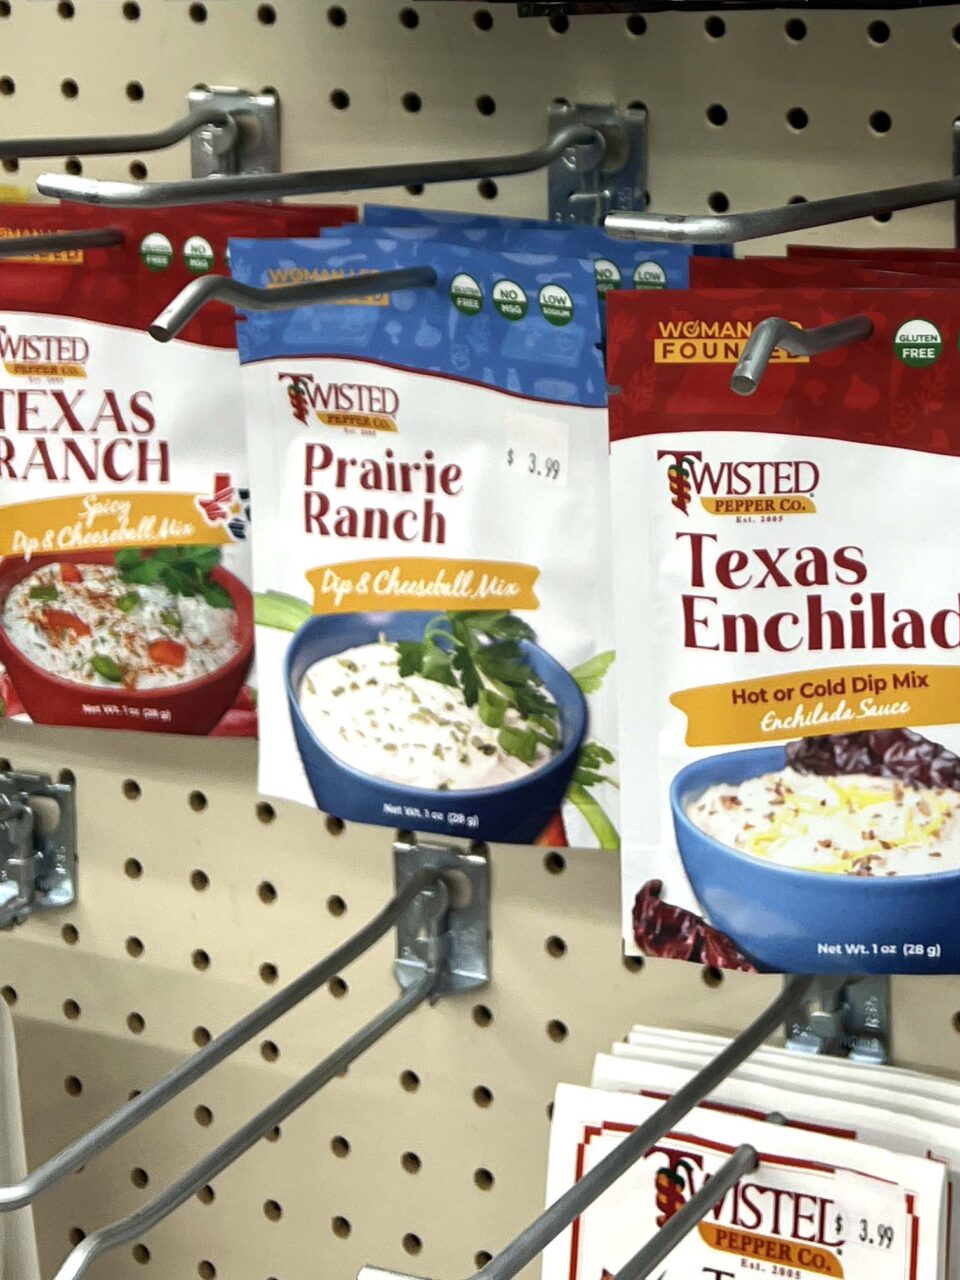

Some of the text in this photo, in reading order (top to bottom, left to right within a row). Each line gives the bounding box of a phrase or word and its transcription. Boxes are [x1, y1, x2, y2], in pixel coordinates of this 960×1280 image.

[500, 289, 517, 300] NO
[543, 295, 567, 305] LOW
[658, 320, 751, 338] WOMAN
[899, 334, 937, 342] GLUTEN
[902, 348, 935, 358] FREE
[278, 372, 399, 428] TWISTED
[305, 442, 464, 496] Prairie
[507, 448, 561, 481] $ 3.99
[657, 450, 820, 517] TWISTED
[304, 491, 446, 544] Ranch
[715, 500, 775, 512] PEPPER
[675, 531, 868, 590] Texas
[731, 671, 929, 705] Hot or Cold Dip Mix
[759, 697, 910, 734] Enchilada Sauce
[817, 943, 841, 954] Net
[845, 943, 870, 954] Wt.
[880, 945, 896, 954] oz
[903, 943, 924, 957] (28
[927, 943, 941, 957] g)
[715, 1229, 793, 1263] PEPPER
[835, 1214, 894, 1249] $ 3.99
